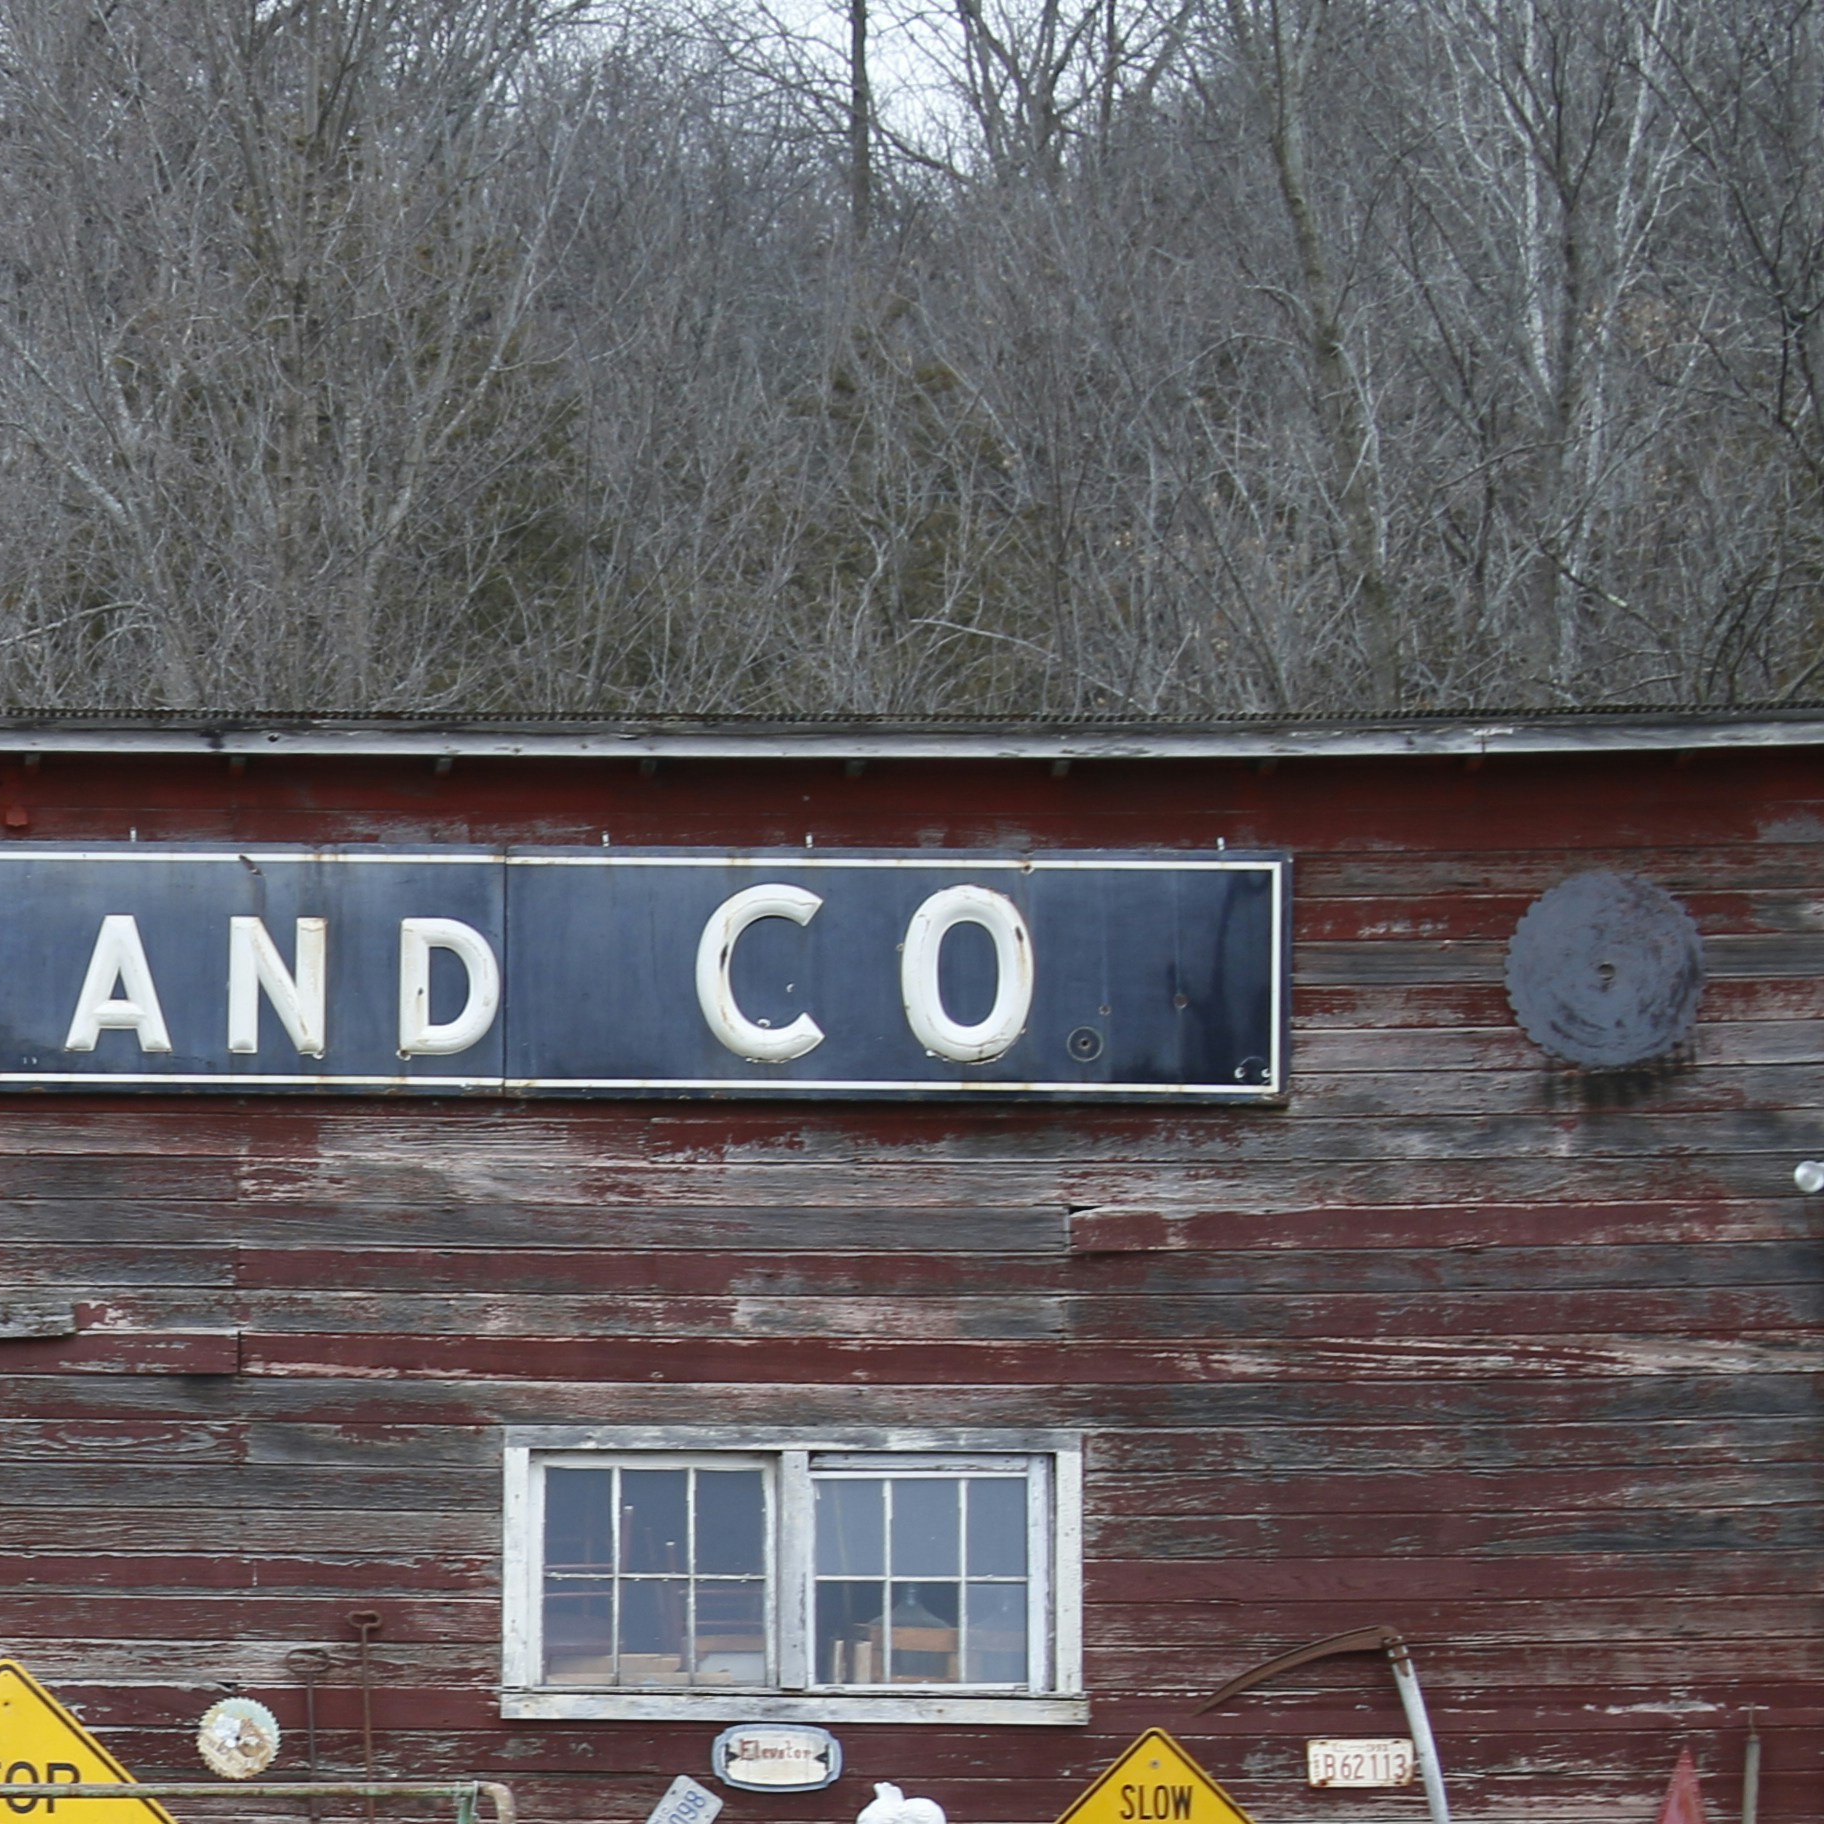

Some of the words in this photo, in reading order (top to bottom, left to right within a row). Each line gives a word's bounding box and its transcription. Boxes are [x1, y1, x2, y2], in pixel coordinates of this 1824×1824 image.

[64, 914, 501, 1061] AND
[694, 882, 1036, 1064] CO
[738, 1738, 812, 1762] Elevator
[1119, 1784, 1193, 1821] SLOW
